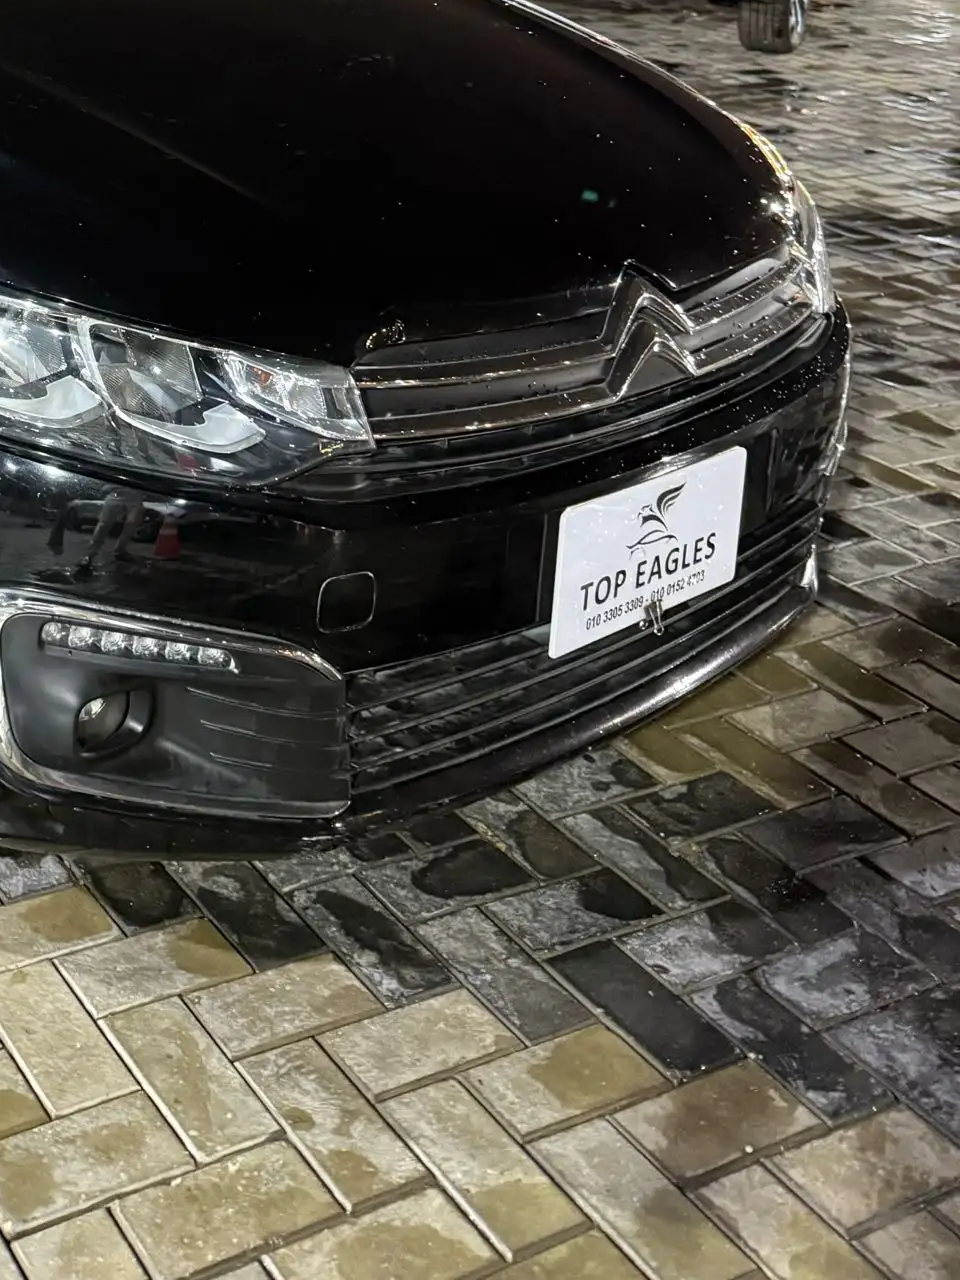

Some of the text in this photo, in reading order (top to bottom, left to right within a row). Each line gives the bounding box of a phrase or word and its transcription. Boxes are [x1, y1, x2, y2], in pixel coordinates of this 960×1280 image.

[580, 532, 717, 611] TOP EAGLES
[586, 613, 601, 630] 010
[603, 604, 623, 623] 3305
[624, 596, 644, 614] 3309
[666, 578, 685, 596] 0152
